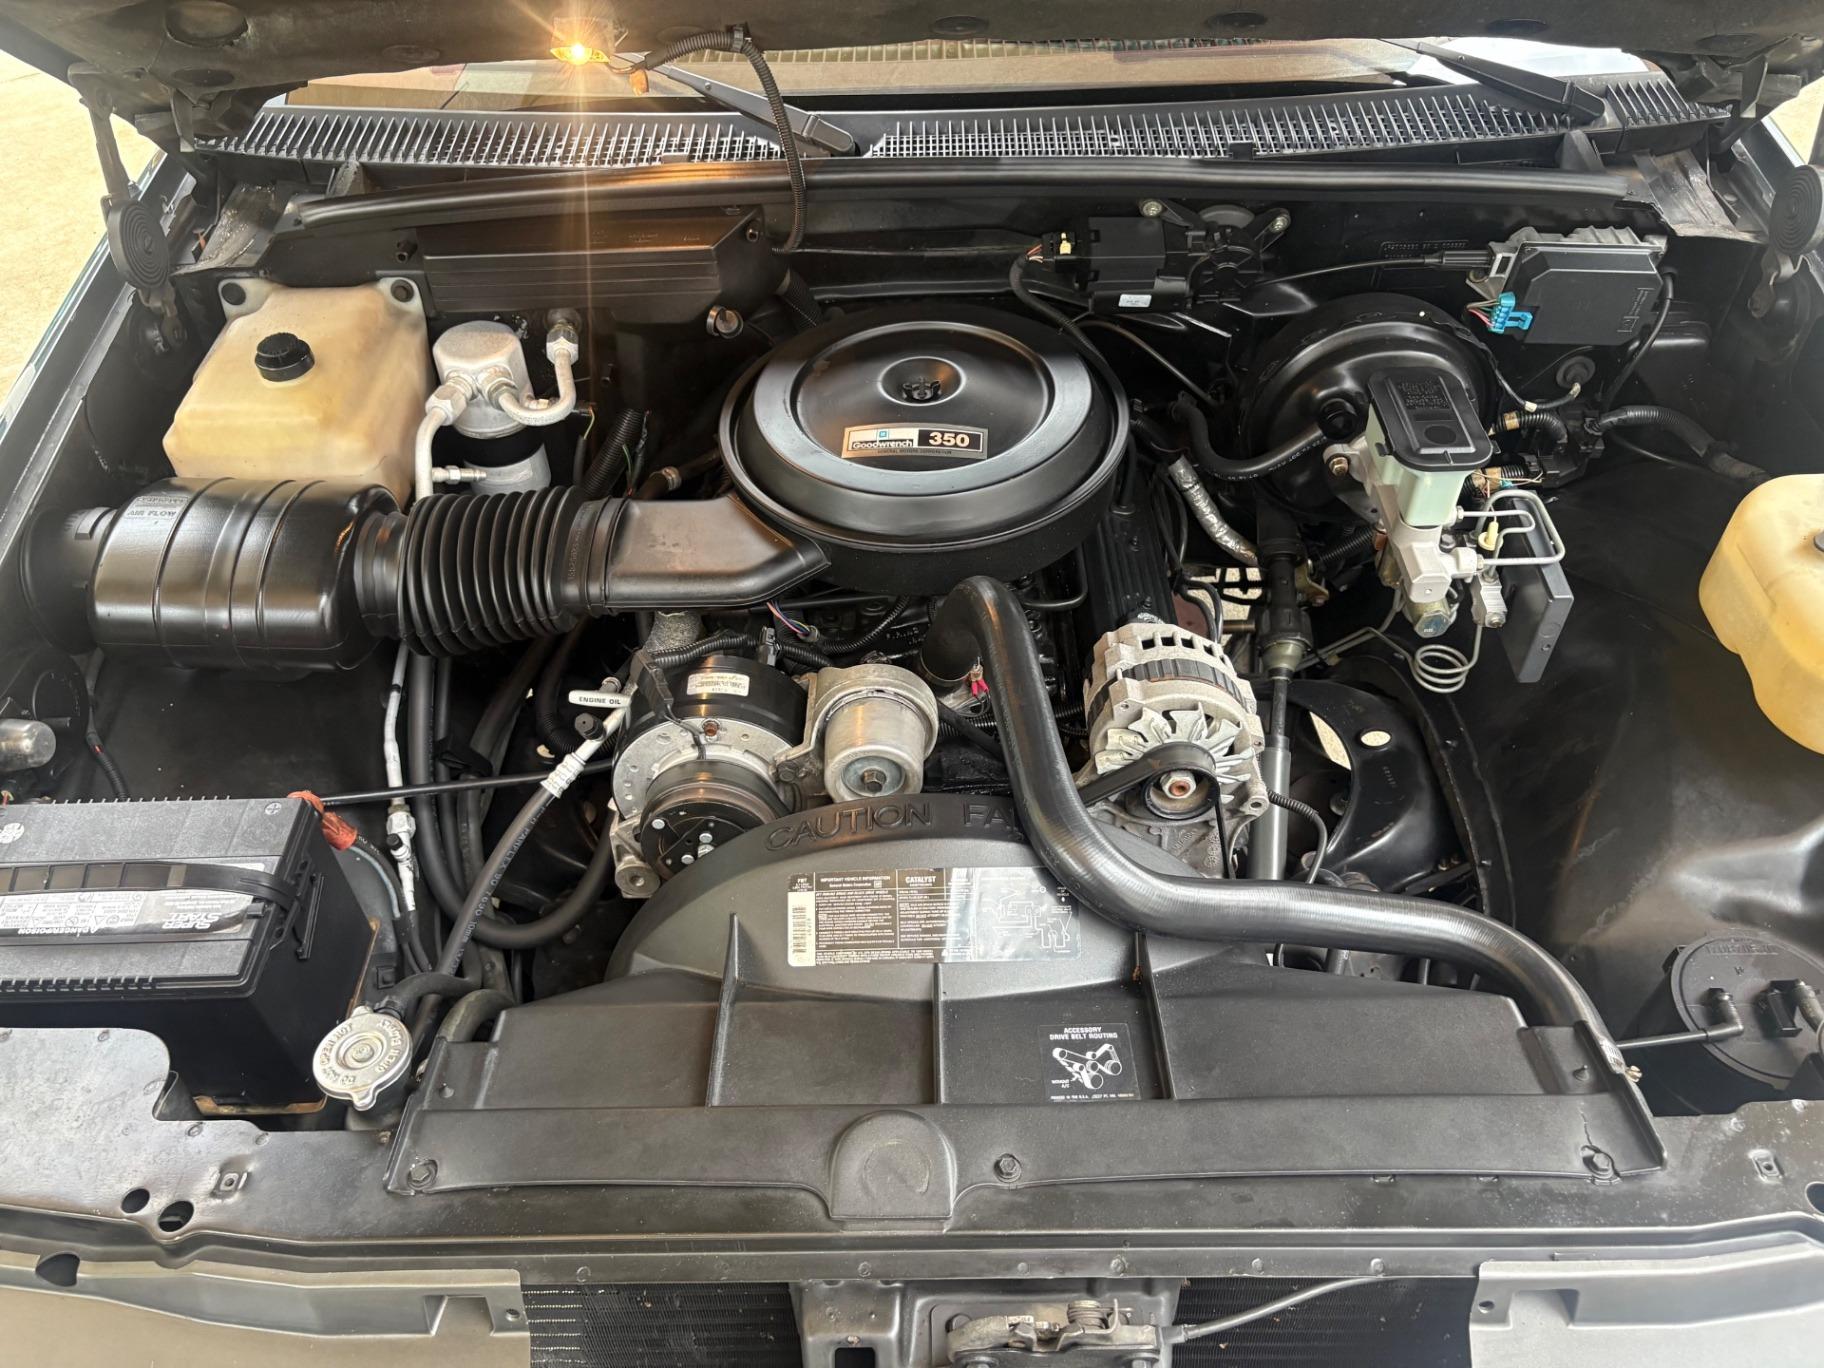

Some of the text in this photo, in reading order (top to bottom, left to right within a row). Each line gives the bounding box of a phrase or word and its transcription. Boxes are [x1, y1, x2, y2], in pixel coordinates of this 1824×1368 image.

[852, 438, 913, 450] Goodwrench
[928, 431, 970, 448] 350
[578, 696, 607, 704] ENGINE
[765, 803, 932, 851] CAUTION
[905, 875, 937, 884] CATALYST
[167, 912, 222, 922] START
[161, 919, 212, 930] SUPER
[1063, 1026, 1102, 1034] ACCESSORY
[1049, 1033, 1070, 1041] DRIVE
[1088, 1032, 1118, 1040] ROUTING
